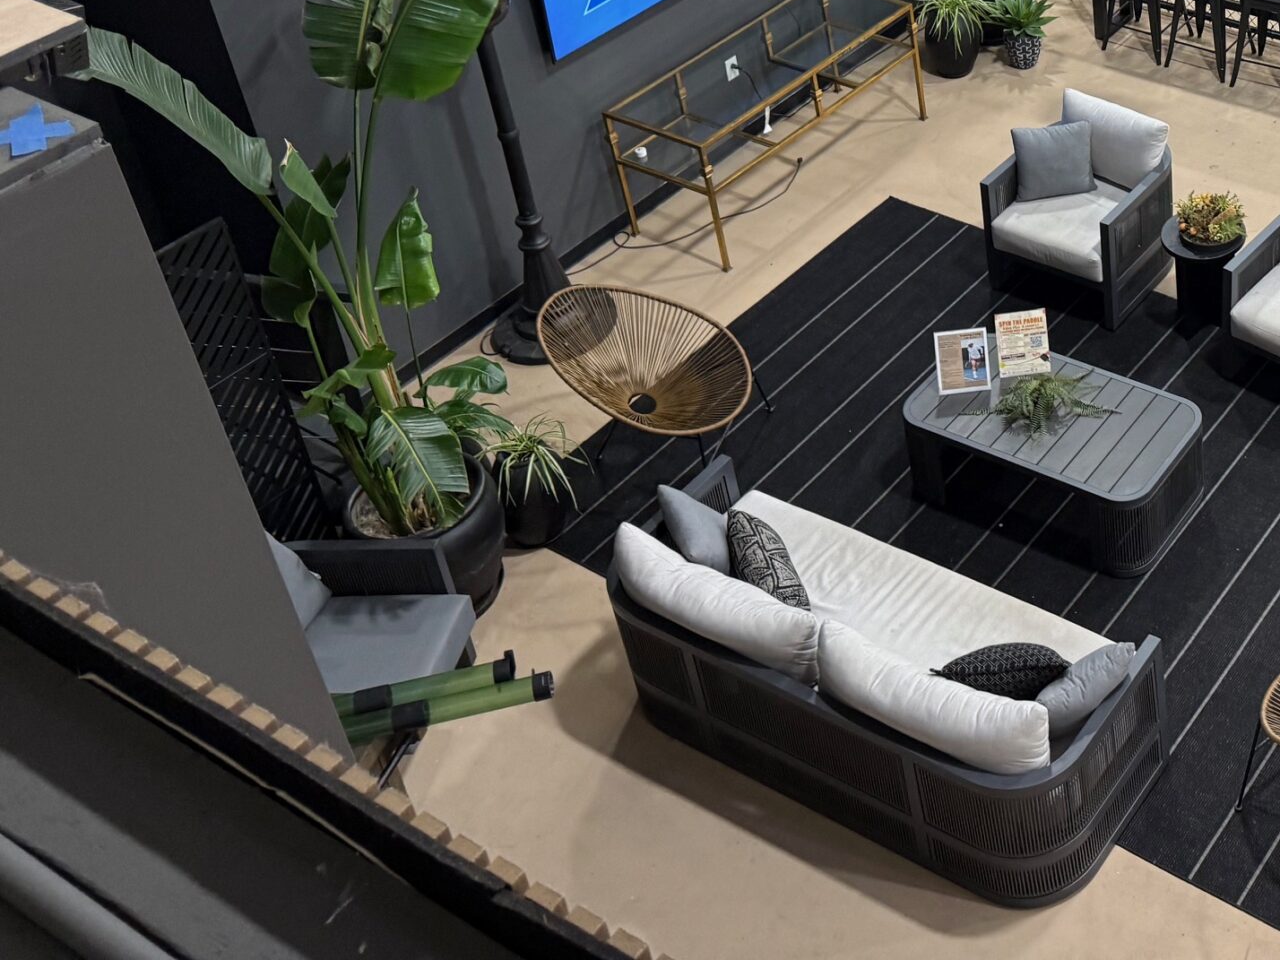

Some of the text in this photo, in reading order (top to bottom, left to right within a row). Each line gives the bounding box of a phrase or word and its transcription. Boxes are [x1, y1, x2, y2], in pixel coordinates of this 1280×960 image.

[998, 319, 1011, 327] SPIN
[1012, 318, 1022, 326] THE
[1023, 316, 1043, 324] PADDLE
